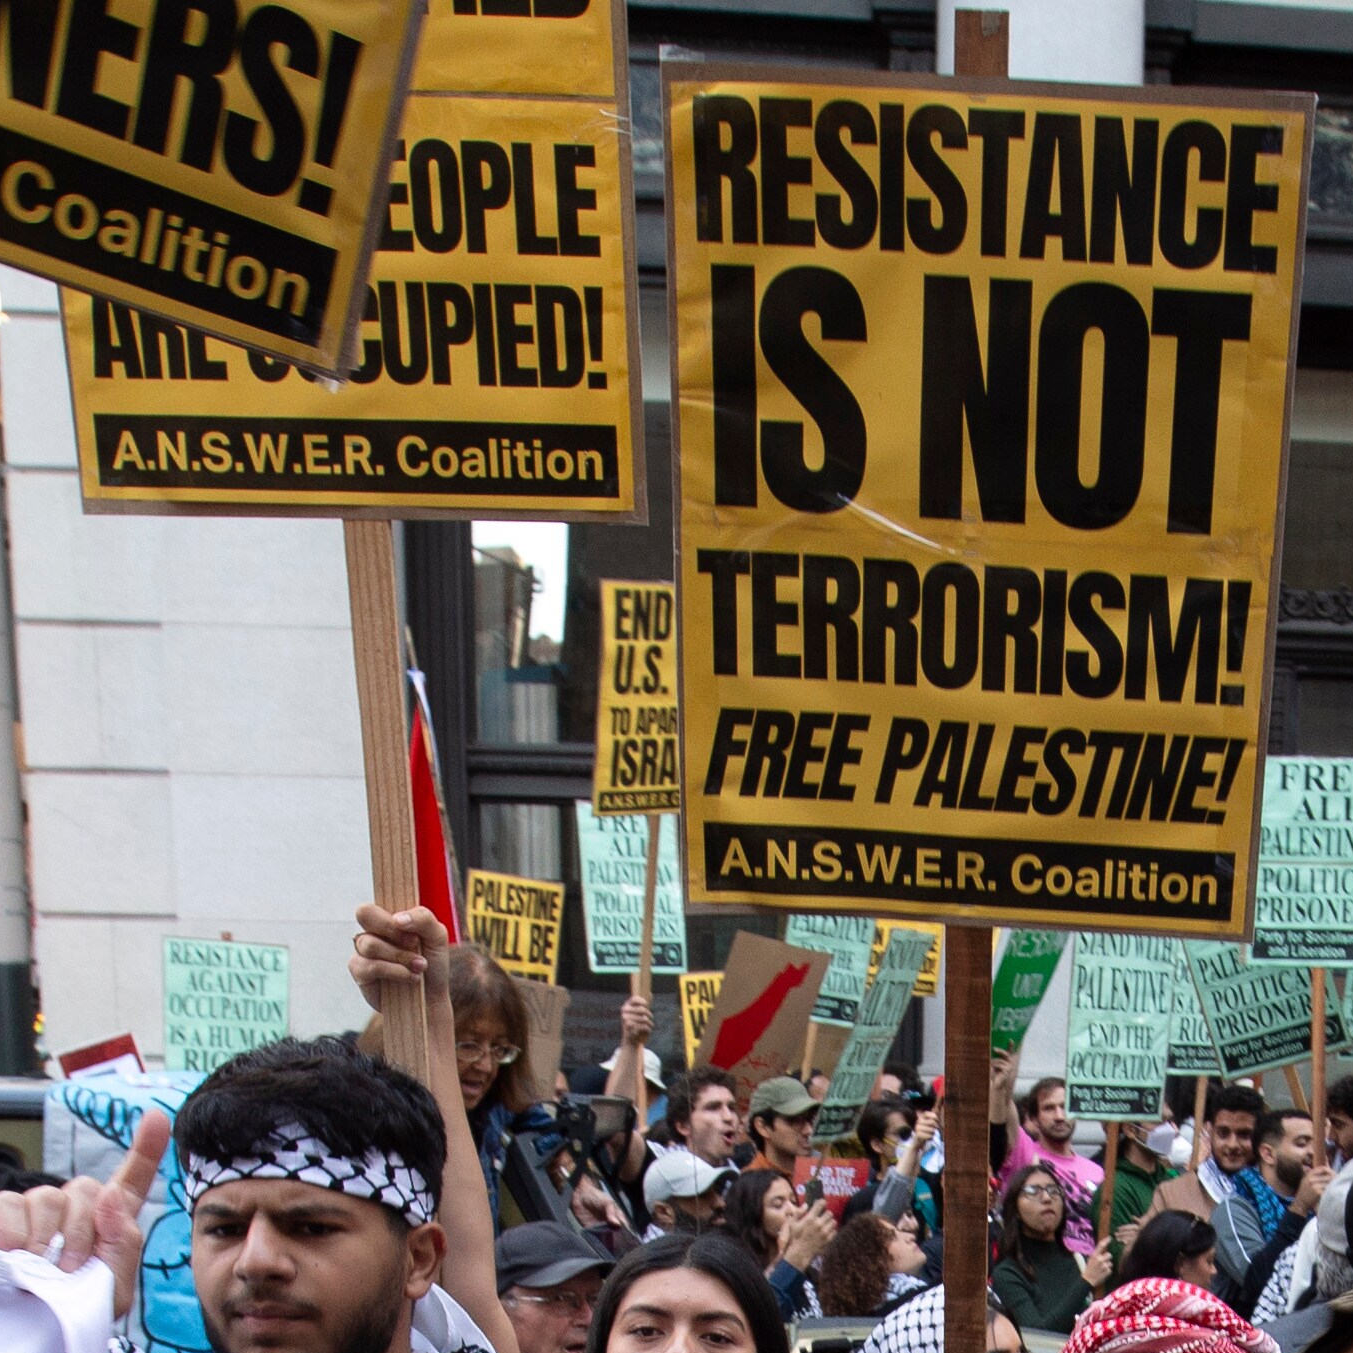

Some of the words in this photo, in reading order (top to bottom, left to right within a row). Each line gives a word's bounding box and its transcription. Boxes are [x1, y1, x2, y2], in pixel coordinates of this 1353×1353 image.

[374, 138, 601, 257] EOPLE
[693, 94, 1284, 274] RESISTANCE
[0, 159, 311, 318] Coalition
[711, 264, 867, 514] IS
[920, 274, 1250, 536] NOT
[113, 429, 384, 476] A.N.S.W.E.R.
[396, 433, 604, 482] Coalition
[614, 588, 673, 642] END
[696, 548, 1252, 707] TERRORISM!
[614, 644, 668, 696] U.S.
[610, 706, 632, 736] TO
[634, 706, 679, 736] APAR
[611, 739, 679, 788] ISRA
[703, 707, 869, 800] FREE
[875, 718, 1248, 825] PALESTINE!
[721, 839, 997, 893] A.N.S.W.E.R.
[1011, 847, 1218, 906] Coalition
[473, 877, 559, 922] PALESTINE
[169, 941, 284, 972] RESISTANCE
[528, 923, 555, 965] BE
[169, 993, 284, 1022] OCCUPATION
[187, 969, 268, 996] AGAINST
[1075, 964, 1170, 1014] PALESTINE
[1211, 967, 1312, 1012] POLITICA
[169, 1024, 186, 1045] IS
[189, 1027, 203, 1046] A
[1088, 1023, 1120, 1048] END
[1125, 1025, 1155, 1050] THE
